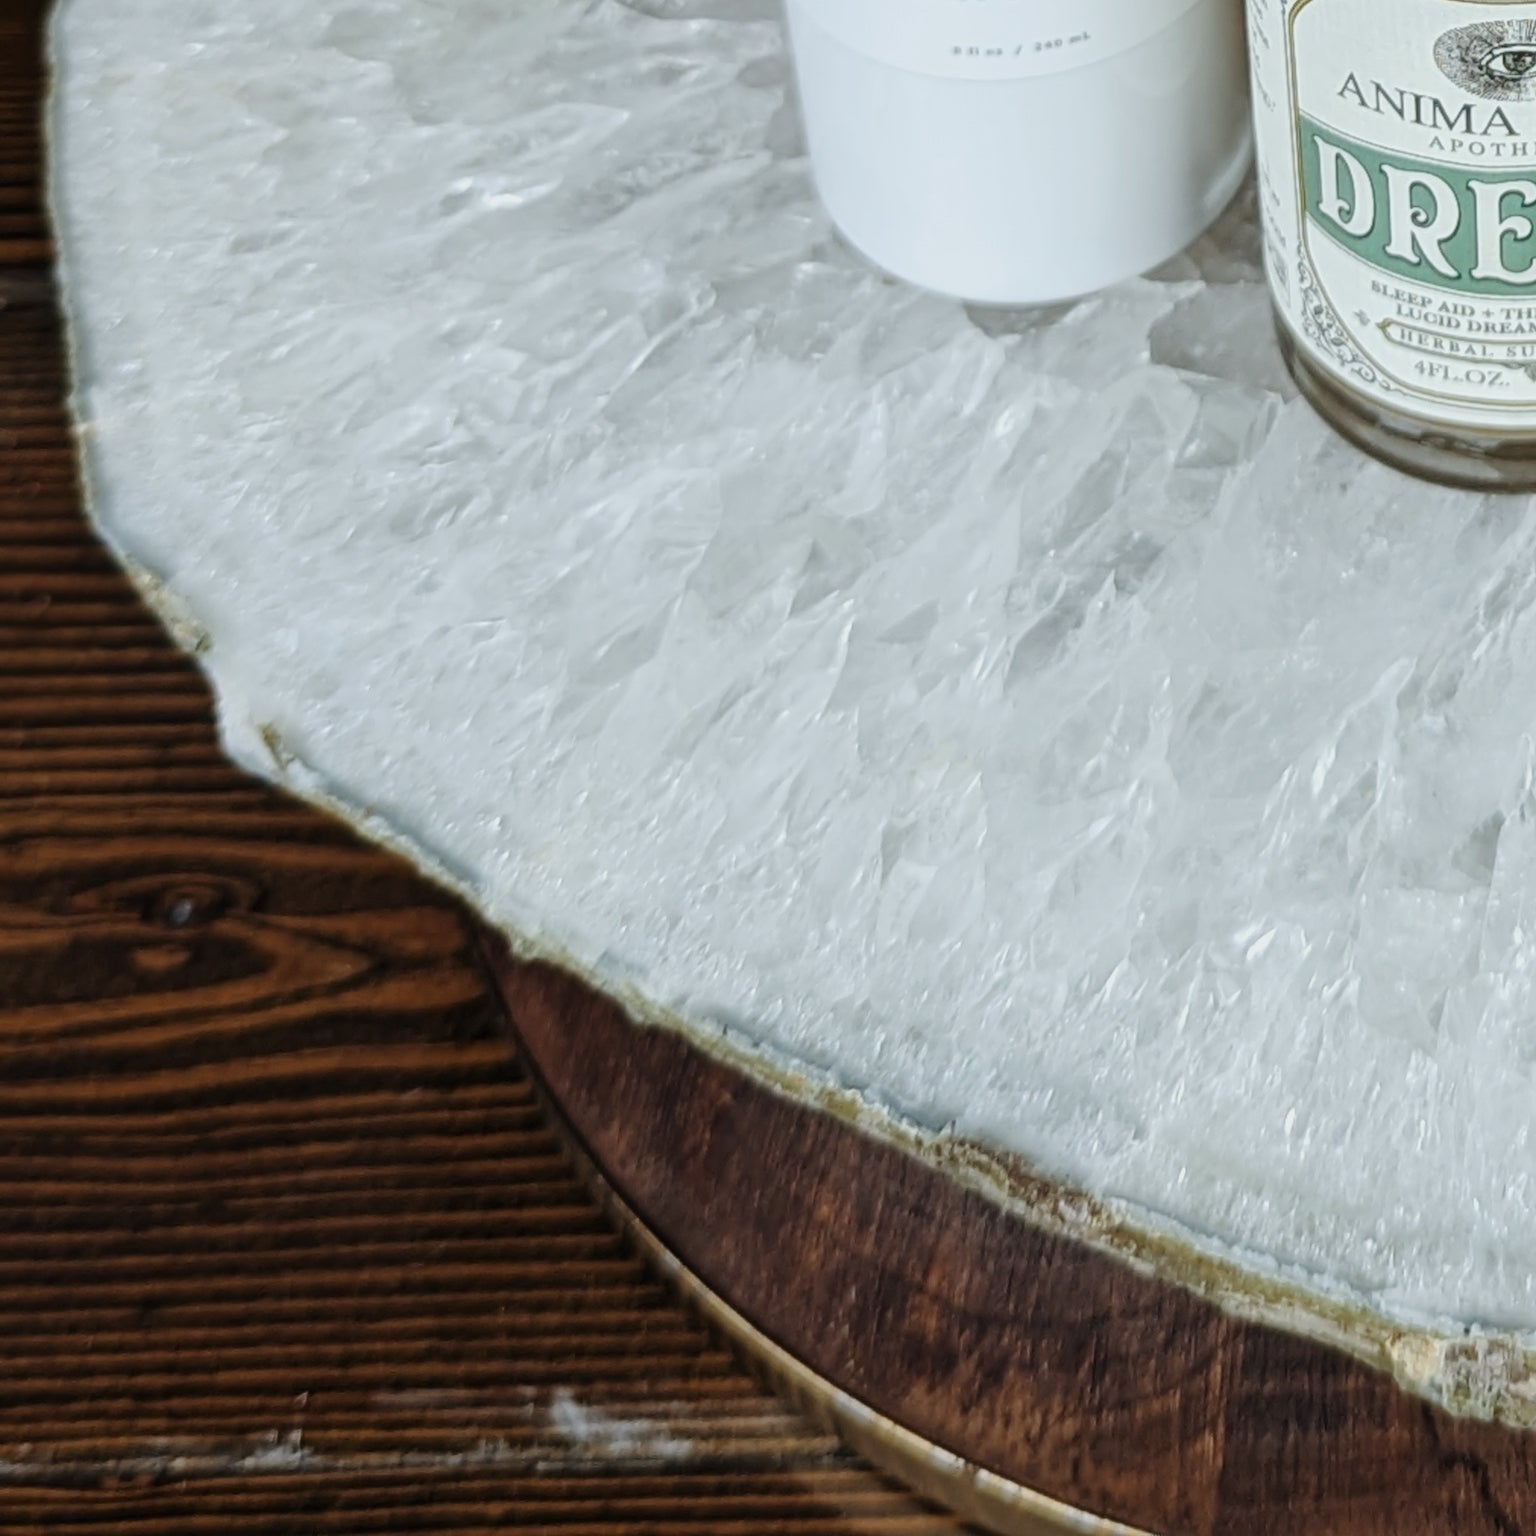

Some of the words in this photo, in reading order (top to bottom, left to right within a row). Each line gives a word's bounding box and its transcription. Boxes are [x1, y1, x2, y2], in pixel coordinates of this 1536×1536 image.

[1336, 71, 1521, 137] ANIMA
[1371, 280, 1433, 309] SLEEP
[1437, 300, 1476, 317] AID
[1395, 302, 1461, 330] LUCID
[1399, 328, 1495, 358] HERBAL
